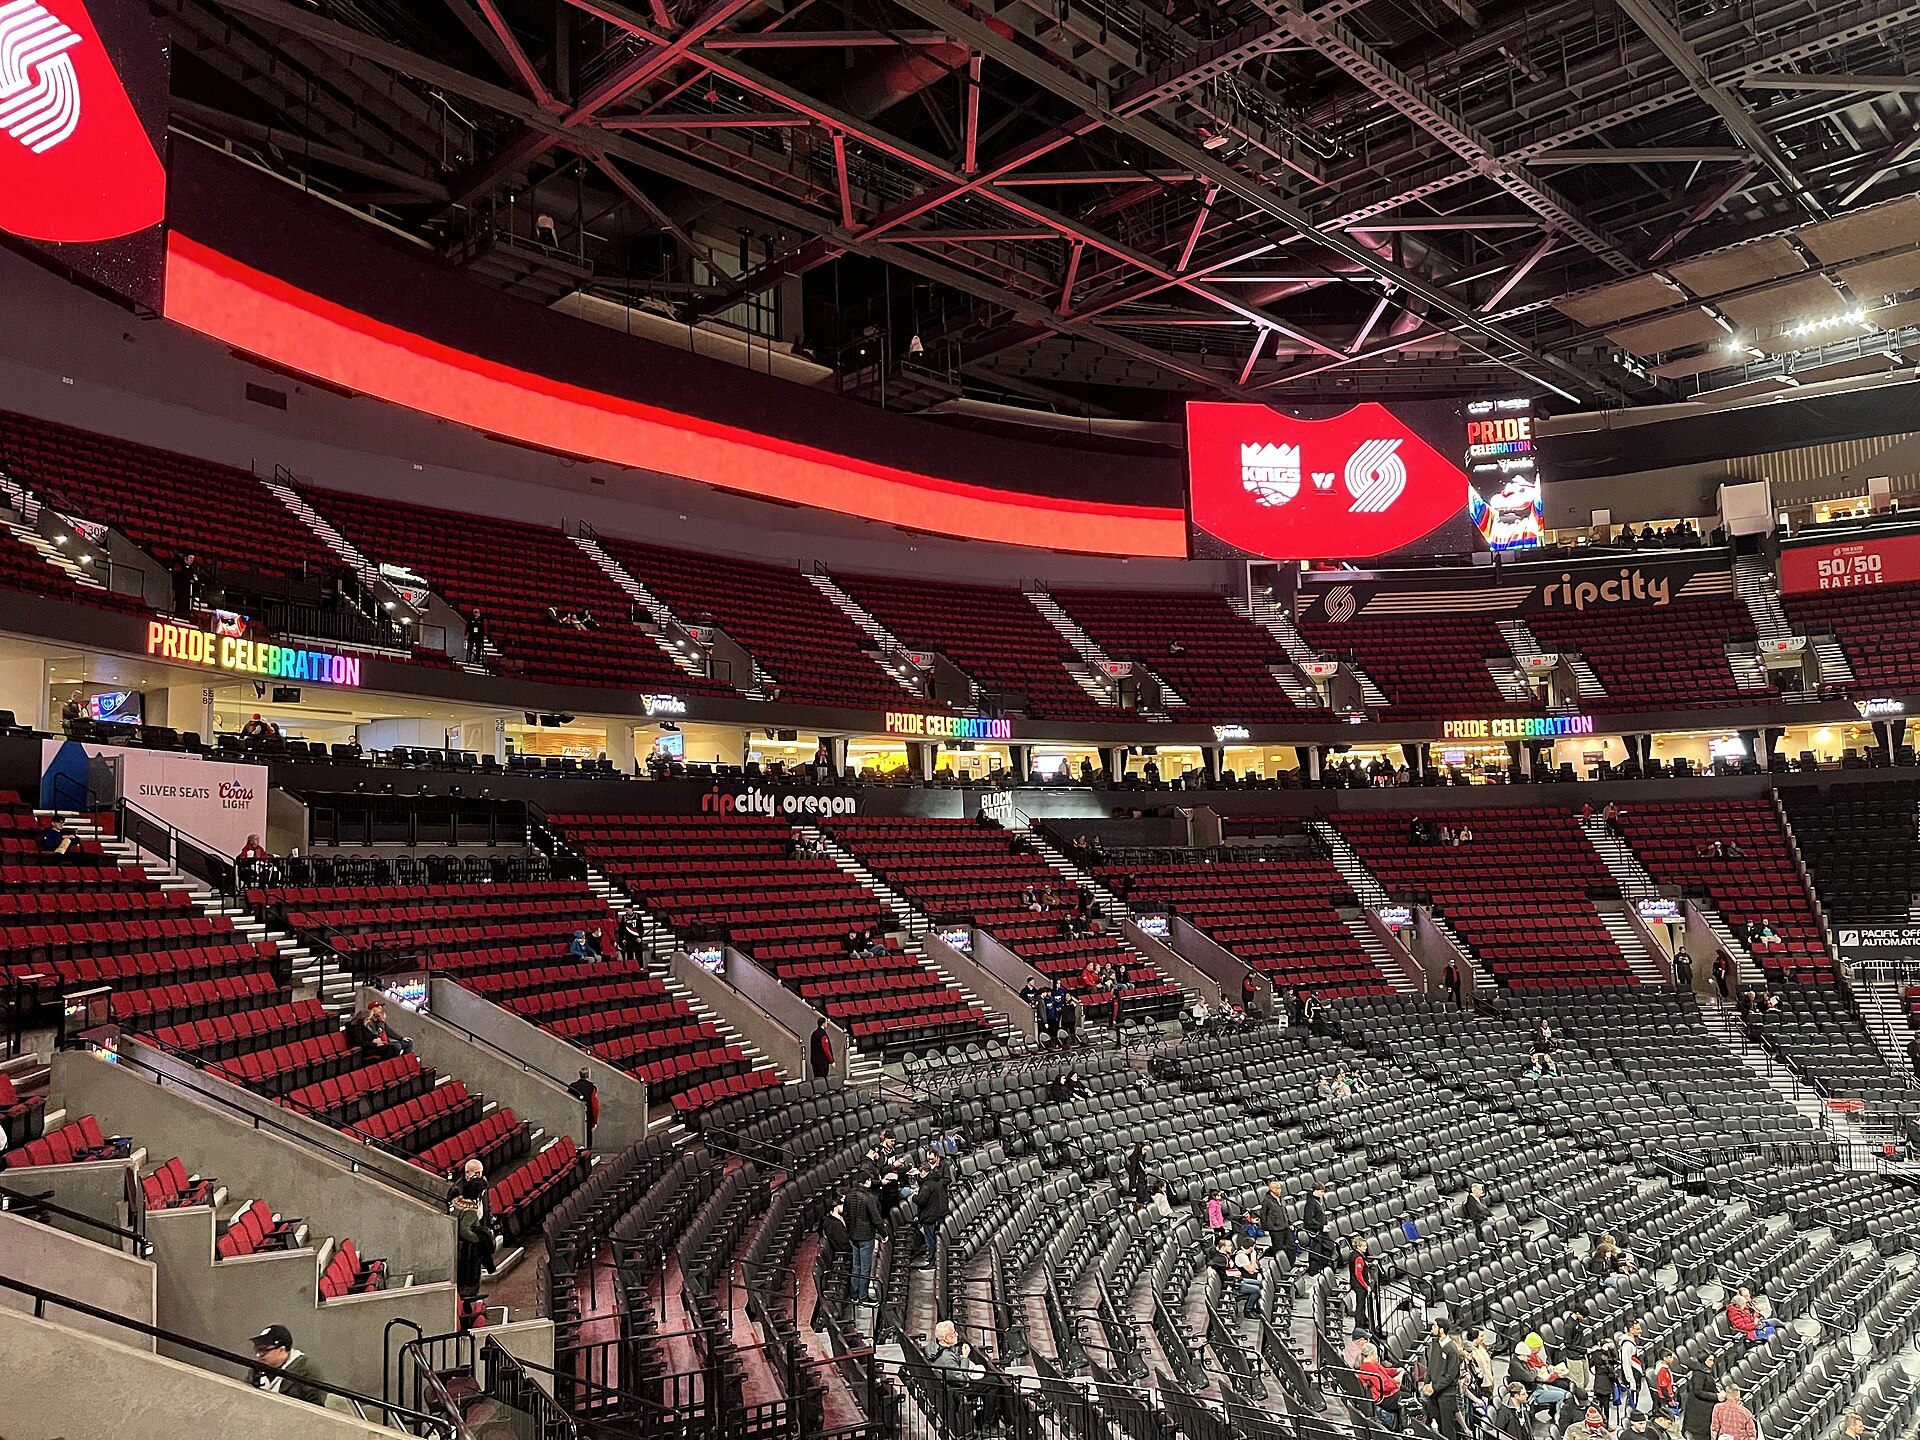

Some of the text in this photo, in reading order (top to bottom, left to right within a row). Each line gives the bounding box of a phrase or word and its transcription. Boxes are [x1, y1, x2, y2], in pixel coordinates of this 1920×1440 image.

[1467, 417, 1532, 445] PRIDE
[1469, 440, 1532, 456] CELEBRATION
[1242, 466, 1301, 482] KINGS
[88, 525, 106, 538] 308
[1817, 554, 1882, 577] 50/50
[1819, 572, 1884, 589] RAFFLE
[1543, 569, 1670, 611] ripcity
[1790, 638, 1805, 646] 315
[148, 621, 361, 687] PRIDE CELEBRATION
[646, 696, 687, 716] jamba
[1861, 698, 1904, 717] jamba
[885, 712, 1011, 738] PRIDE CELEBRATION
[1443, 715, 1594, 738] PRIDE CELEBRATION
[139, 784, 210, 799] SILVER SEATS
[218, 782, 254, 800] Coors
[981, 790, 1013, 809] BLOCK
[222, 800, 250, 809] LIGHT
[1861, 929, 1899, 938] PACIFIC
